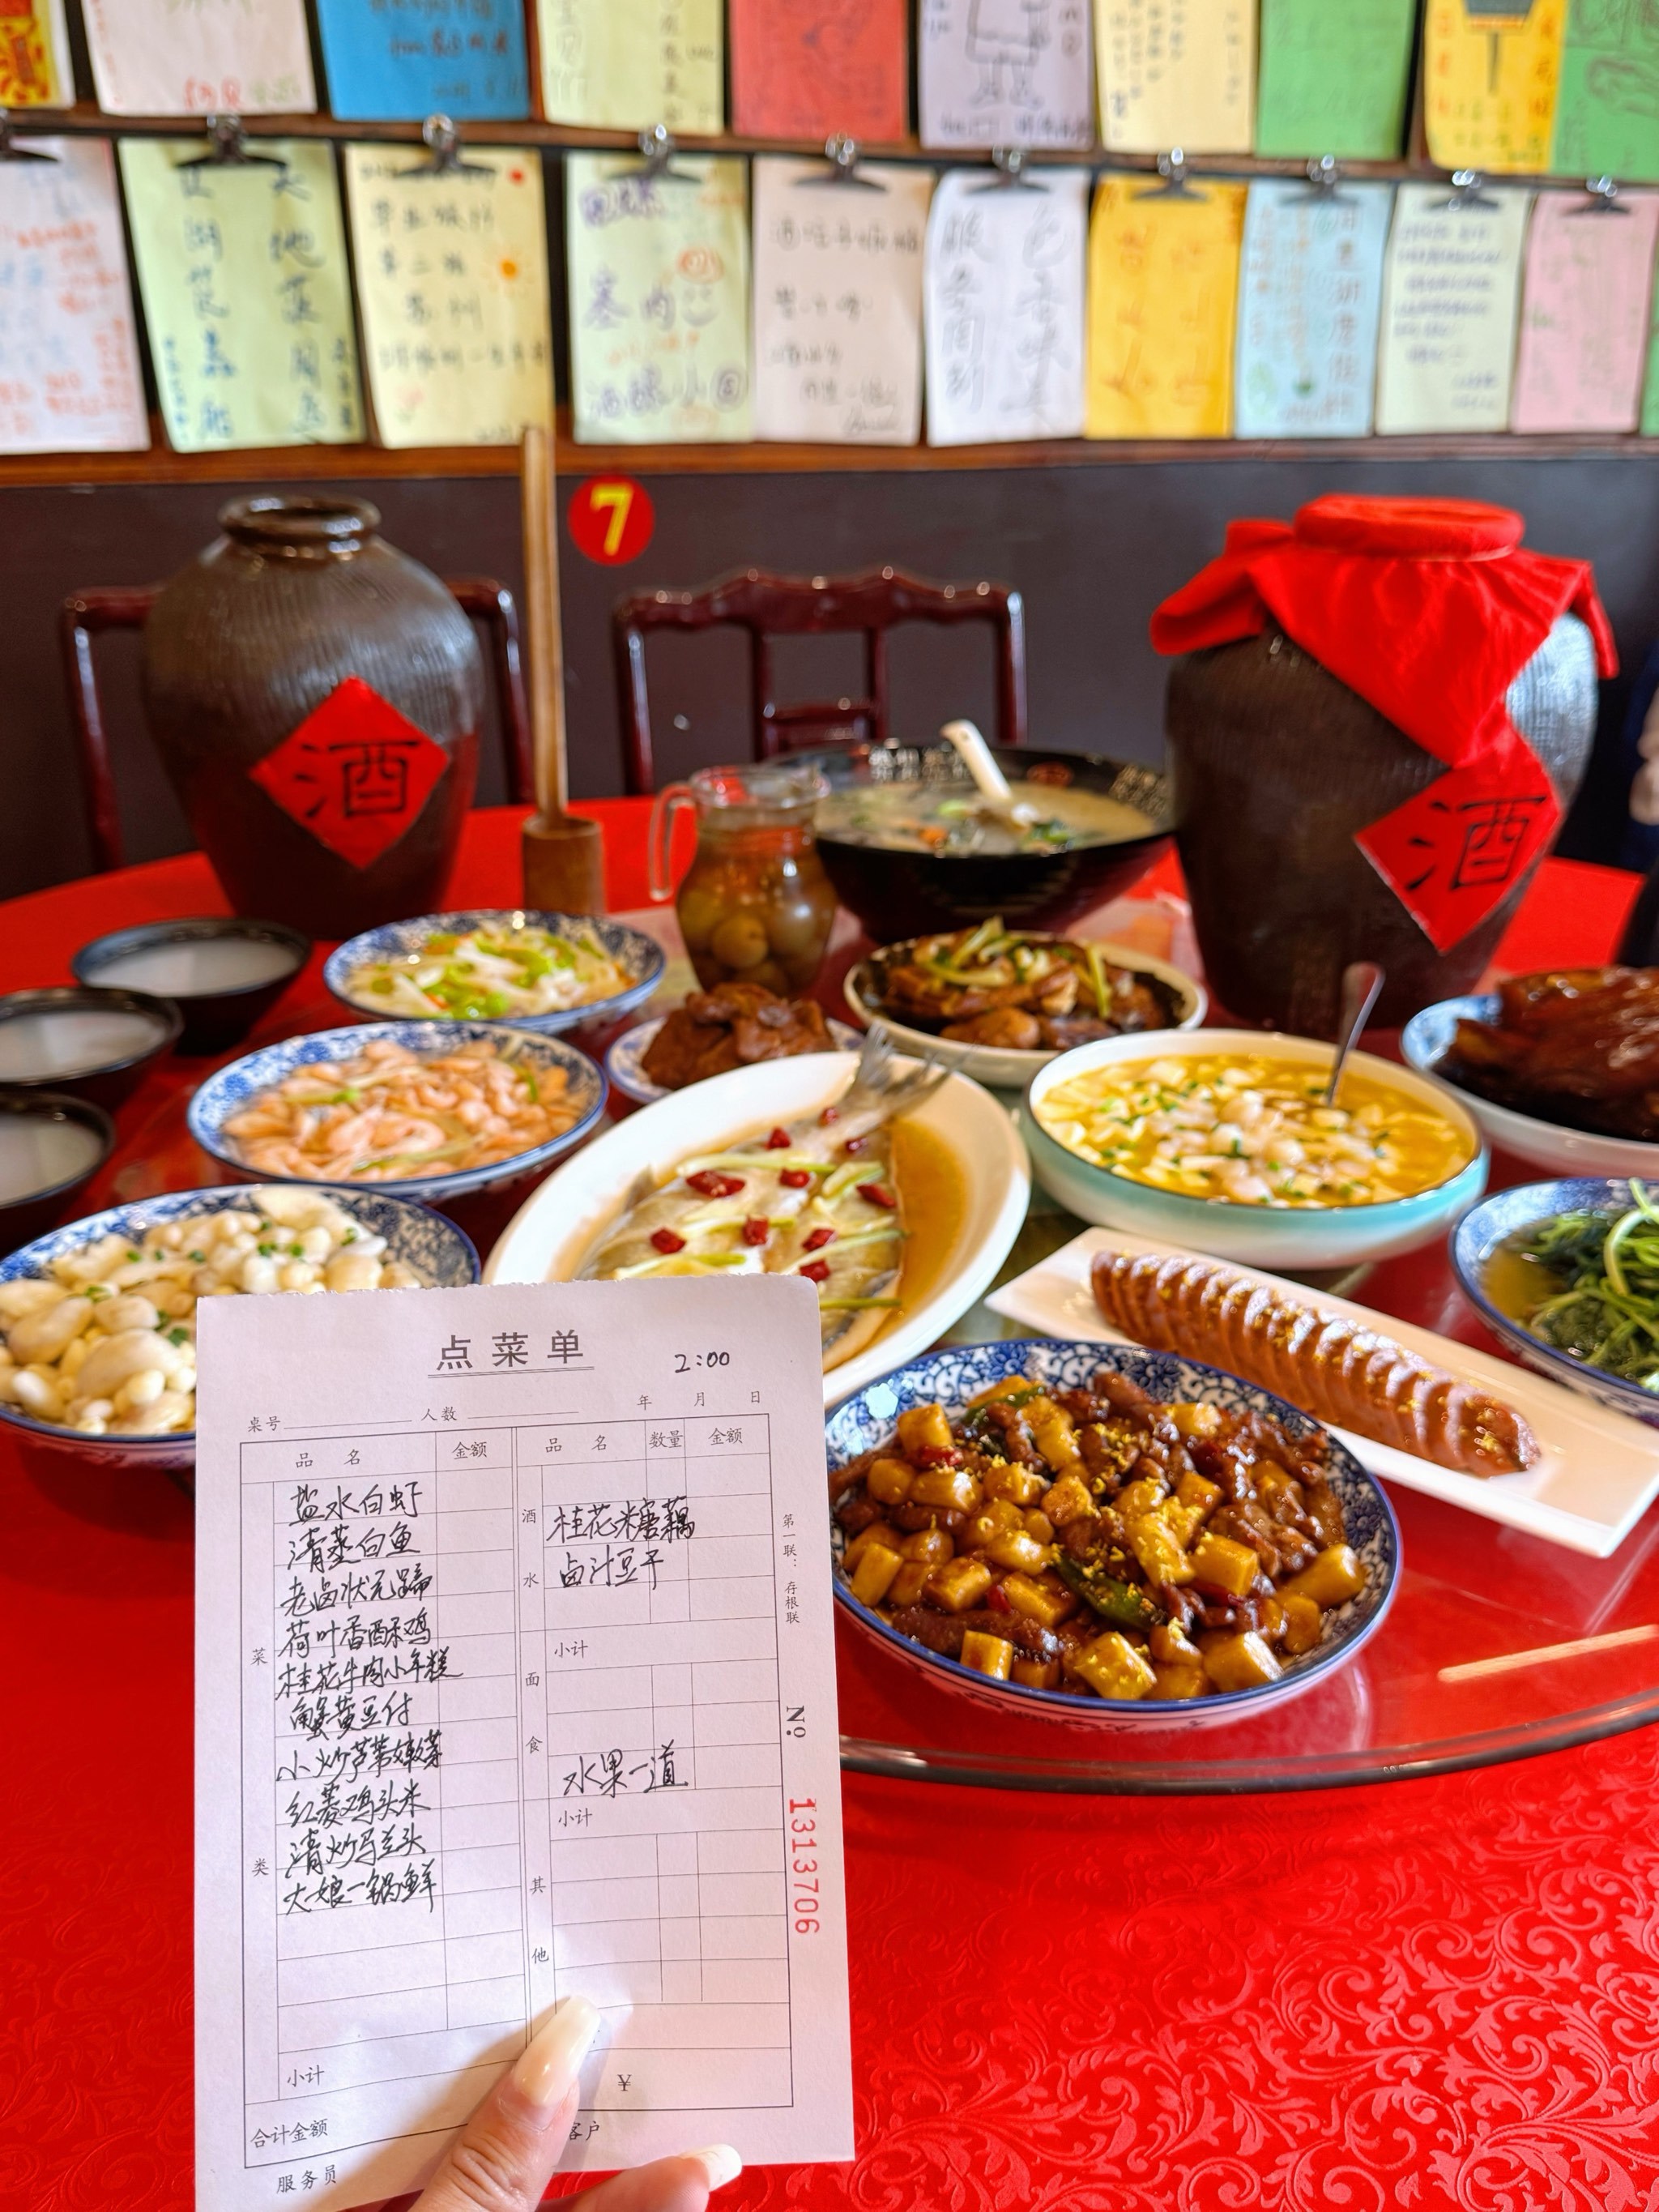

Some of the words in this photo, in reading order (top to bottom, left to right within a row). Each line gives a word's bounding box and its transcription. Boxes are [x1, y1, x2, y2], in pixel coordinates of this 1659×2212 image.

[590, 482, 634, 556] 7
[292, 741, 420, 818] 酒
[1405, 796, 1547, 890] 酒
[436, 1329, 583, 1370] 点菜单
[674, 1352, 730, 1373] 2:00
[248, 1416, 281, 1433] 桌号
[420, 1407, 458, 1422] 人数
[637, 1394, 652, 1411] 年
[693, 1392, 706, 1407] 月
[750, 1390, 761, 1404] 日
[452, 1441, 488, 1460] 金额
[649, 1429, 684, 1450] 数量
[708, 1427, 743, 1445] 金额
[289, 1481, 422, 1526] 盐水白虾
[522, 1508, 536, 1523] 酒
[546, 1497, 695, 1543] 桂花糖藕
[288, 1521, 420, 1574] 清蒸白鱼
[560, 1544, 664, 1590] 卤汁豆干
[280, 1563, 433, 1616] 老卤状元蹄
[523, 1573, 539, 1588] 水
[784, 1581, 800, 1624] 存根联
[278, 1607, 431, 1658] 荷叶香酥鸡
[554, 1640, 588, 1659] 小计
[250, 1647, 268, 1666] 菜
[275, 1646, 463, 1700] 桂花牛肉小年糕
[525, 1672, 539, 1686] 面
[525, 1736, 543, 1754] 食
[563, 1739, 689, 1798] 水果一道
[558, 1808, 593, 1827] 小计
[252, 1858, 270, 1877] 类
[285, 1822, 425, 1879] 清炒马兰头
[789, 1797, 820, 1934] 1313706
[284, 1859, 436, 1915] 大娘一锅鲜
[529, 1877, 546, 1894] 其
[531, 1948, 549, 1964] 他
[287, 2067, 324, 2088] 小计
[617, 2074, 632, 2091] ¥
[249, 2118, 329, 2149] 合计金额
[276, 2164, 337, 2194] 服务员
